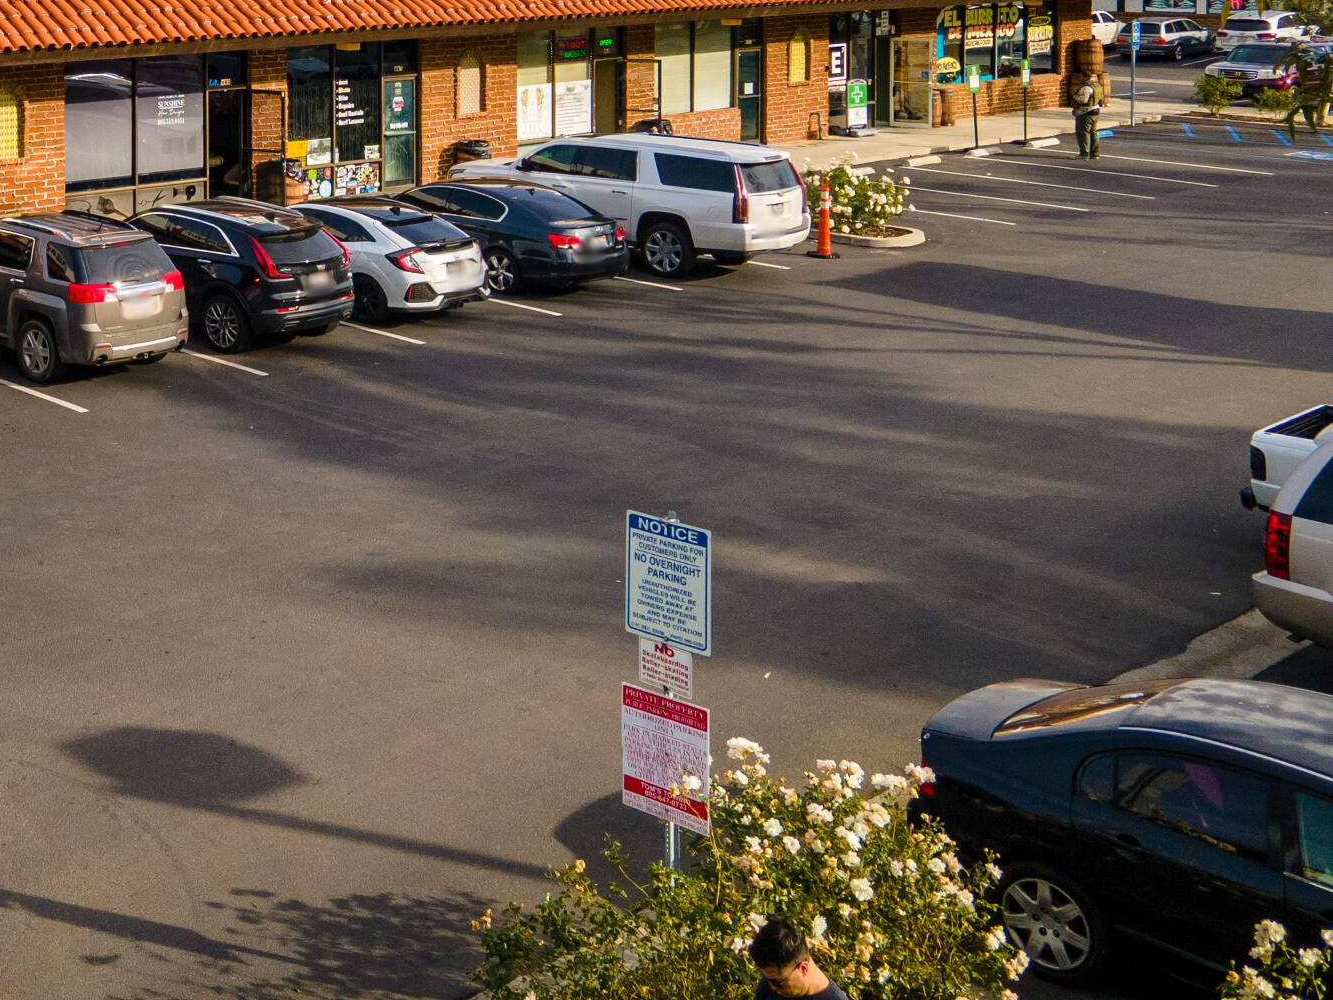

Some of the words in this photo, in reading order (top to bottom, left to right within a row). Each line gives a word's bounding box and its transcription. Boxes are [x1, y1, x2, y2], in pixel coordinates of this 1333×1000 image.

[944, 10, 961, 27] EL
[948, 27, 962, 40] DE
[157, 100, 185, 108] SUNSHINE
[638, 517, 699, 544] NOTICE
[632, 532, 657, 544] PRIVATE
[659, 539, 688, 553] PARKING
[690, 547, 704, 557] FOR
[638, 542, 678, 558] CUSTOMERS
[679, 553, 697, 563] ONLY
[634, 552, 646, 563] NO
[649, 556, 701, 578] OVERNIGHT
[648, 567, 687, 586] PARKING
[638, 584, 668, 598] VEHICLES
[670, 593, 685, 603] WILL
[642, 579, 693, 597] UNAUTHORIZED
[637, 598, 665, 611] OWNERS
[666, 608, 697, 621] EXPENSE
[641, 592, 664, 603] TOWED
[665, 600, 683, 609] AWAY
[632, 611, 660, 625] SUBJECT
[673, 625, 703, 637] CITATION
[647, 609, 661, 617] AND
[662, 614, 675, 622] MAY
[642, 649, 689, 671] Skateboarding
[654, 644, 675, 658] NO
[626, 688, 659, 705] PRIVATE
[661, 699, 704, 719] PROPERTY
[625, 699, 645, 709] PUBLIC
[646, 705, 671, 718] PARKING
[672, 713, 706, 729] PROHIBITED
[625, 708, 673, 728] AUTHORIZED
[673, 723, 707, 740] PARKING
[654, 724, 674, 736] ONLY
[641, 782, 662, 795] TOM'S
